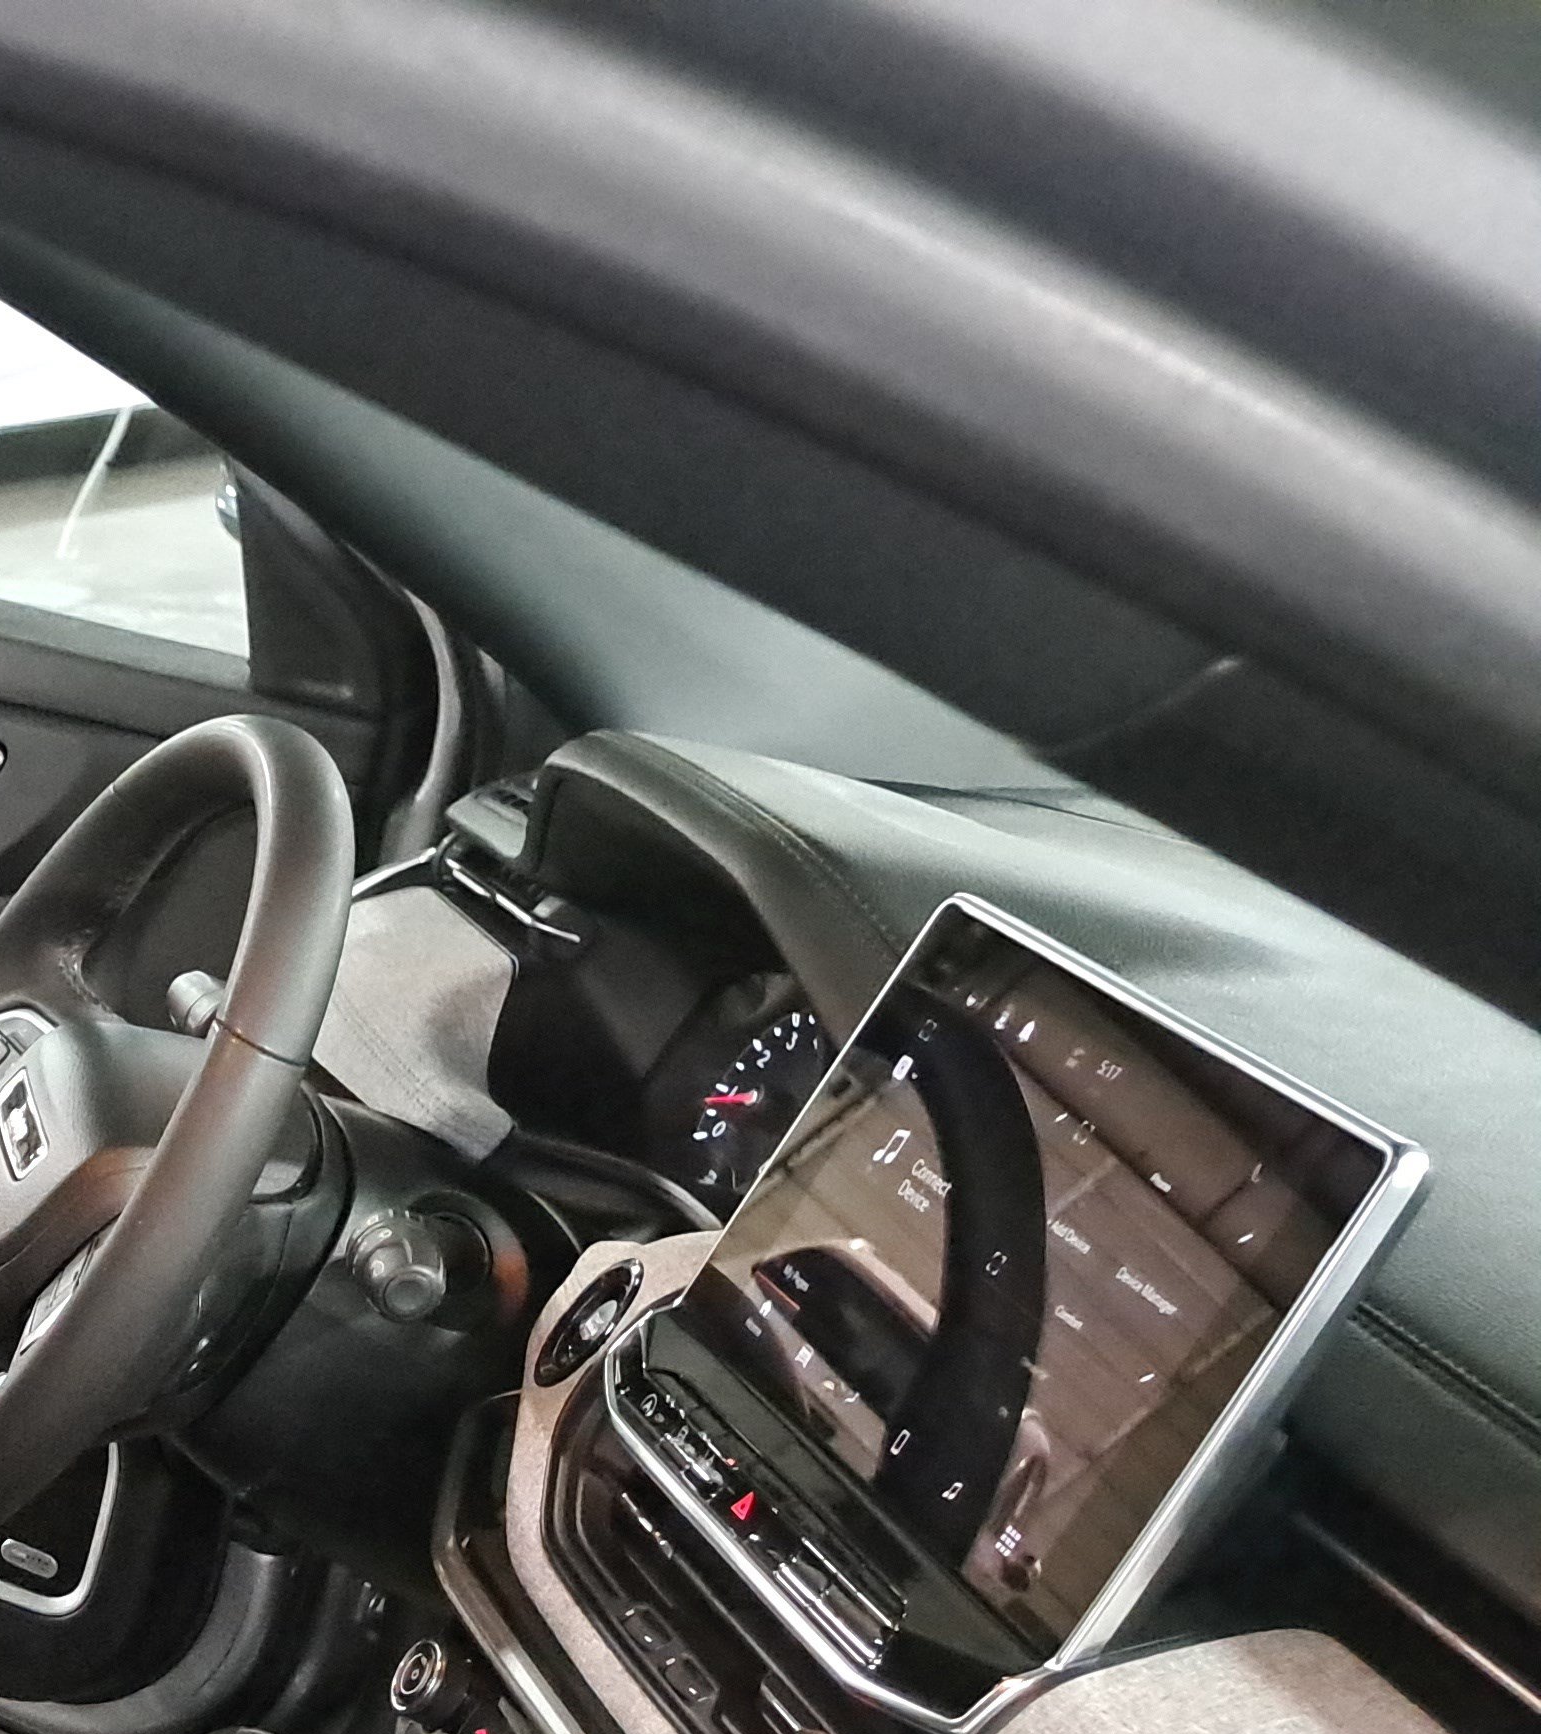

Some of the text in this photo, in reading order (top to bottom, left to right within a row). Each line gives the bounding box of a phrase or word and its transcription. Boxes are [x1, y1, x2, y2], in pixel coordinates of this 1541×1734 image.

[755, 1049, 772, 1069] 2
[711, 1120, 727, 1138] 0
[911, 1158, 952, 1198] Connect
[897, 1178, 930, 1213] Device
